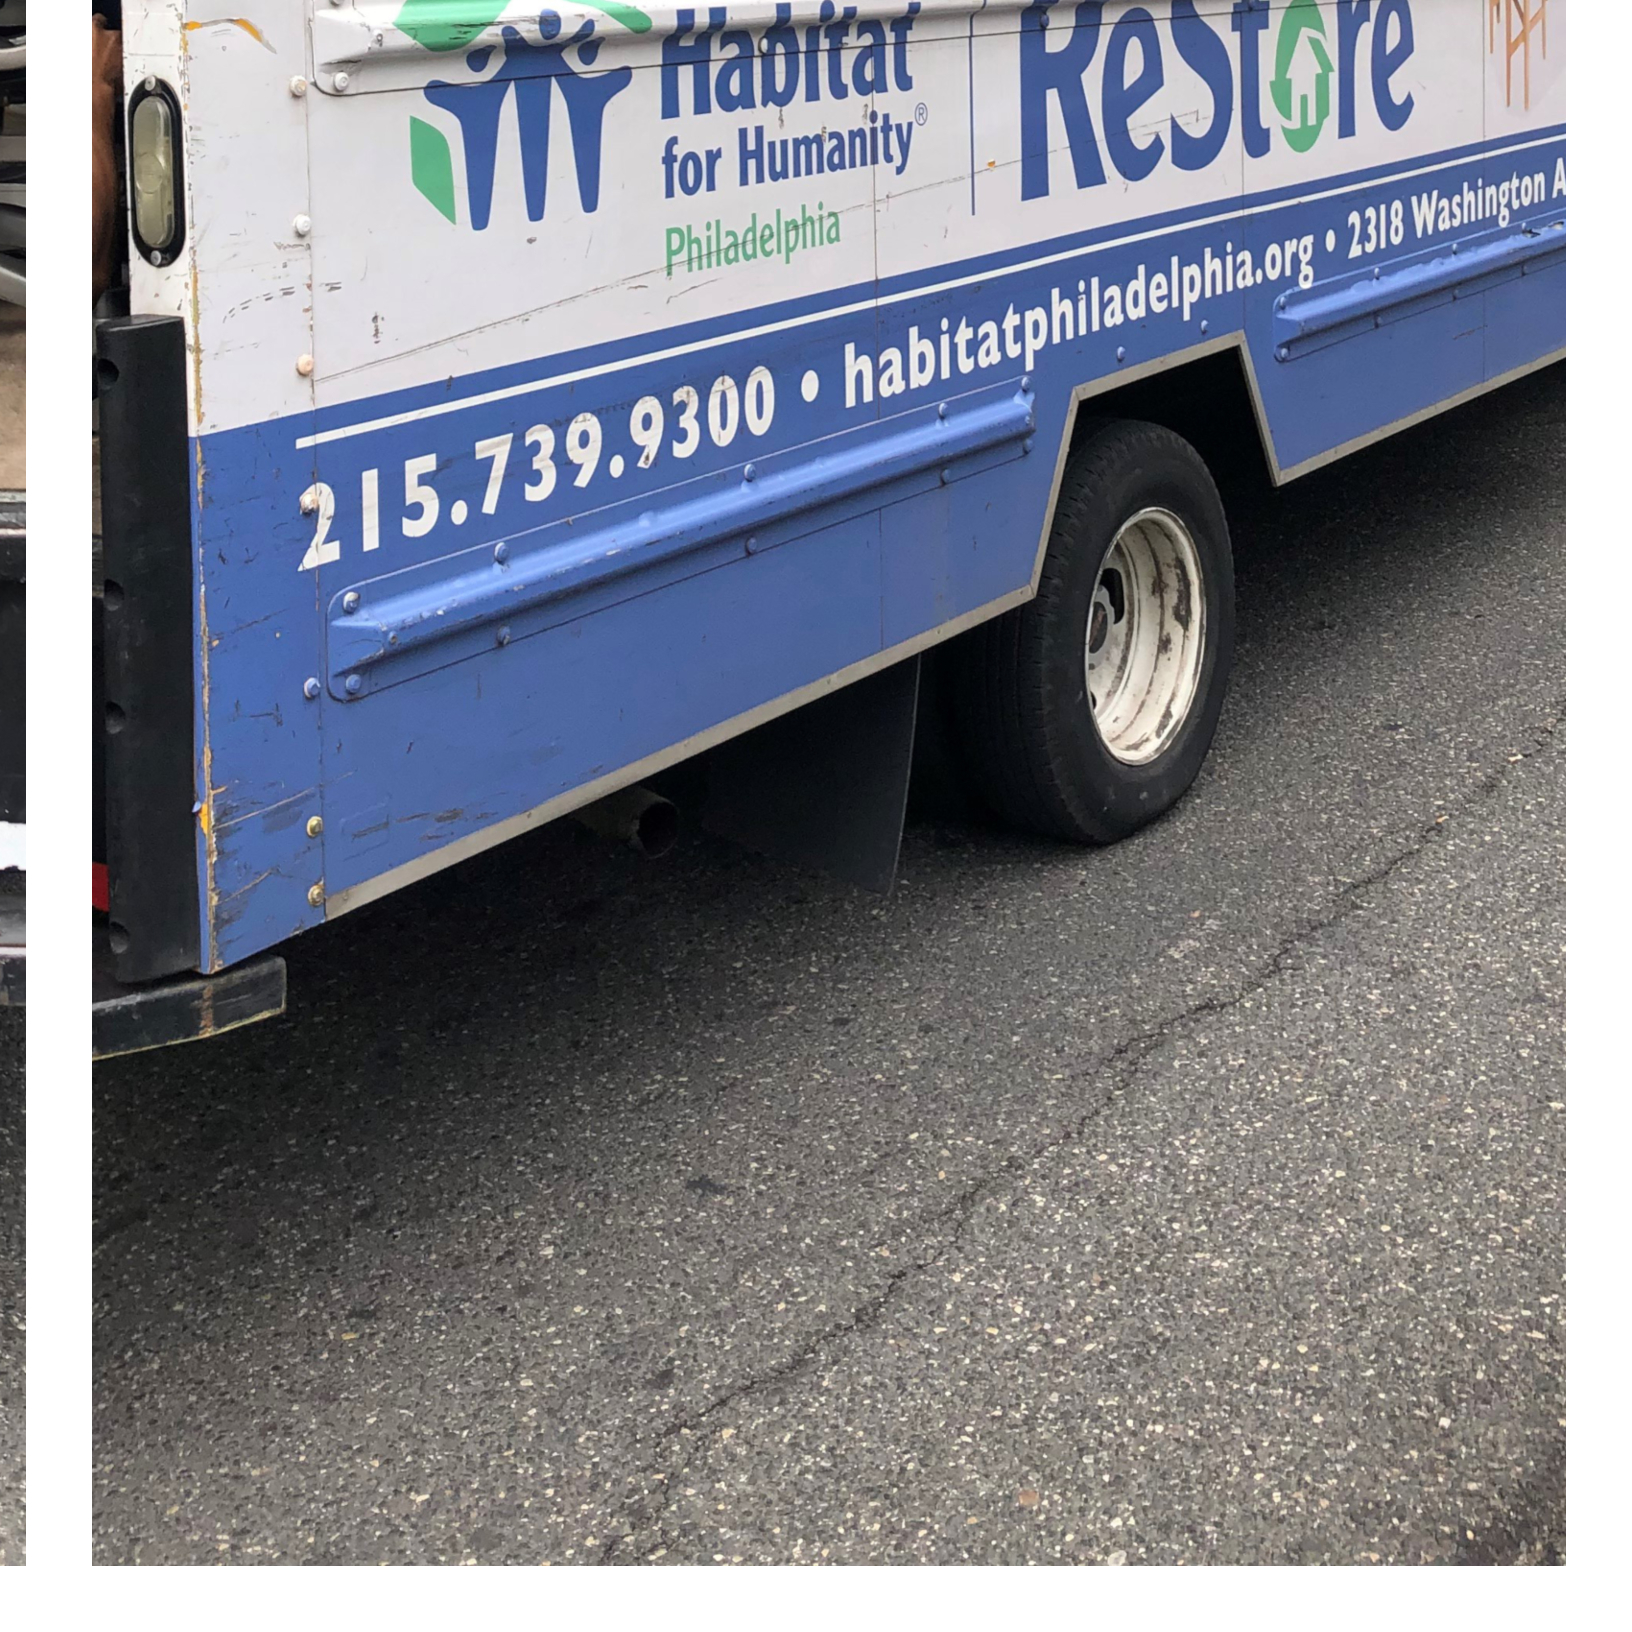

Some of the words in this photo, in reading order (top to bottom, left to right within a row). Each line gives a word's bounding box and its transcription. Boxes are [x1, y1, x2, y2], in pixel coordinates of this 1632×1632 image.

[661, 0, 921, 120] Habitat
[662, 135, 722, 199] for
[666, 200, 841, 277] Philadelphia
[297, 365, 775, 572] 215.739.9300
[844, 231, 1314, 408] habitatphiladelphia.org
[1347, 198, 1403, 259] 2318
[1410, 171, 1546, 239] Washington
